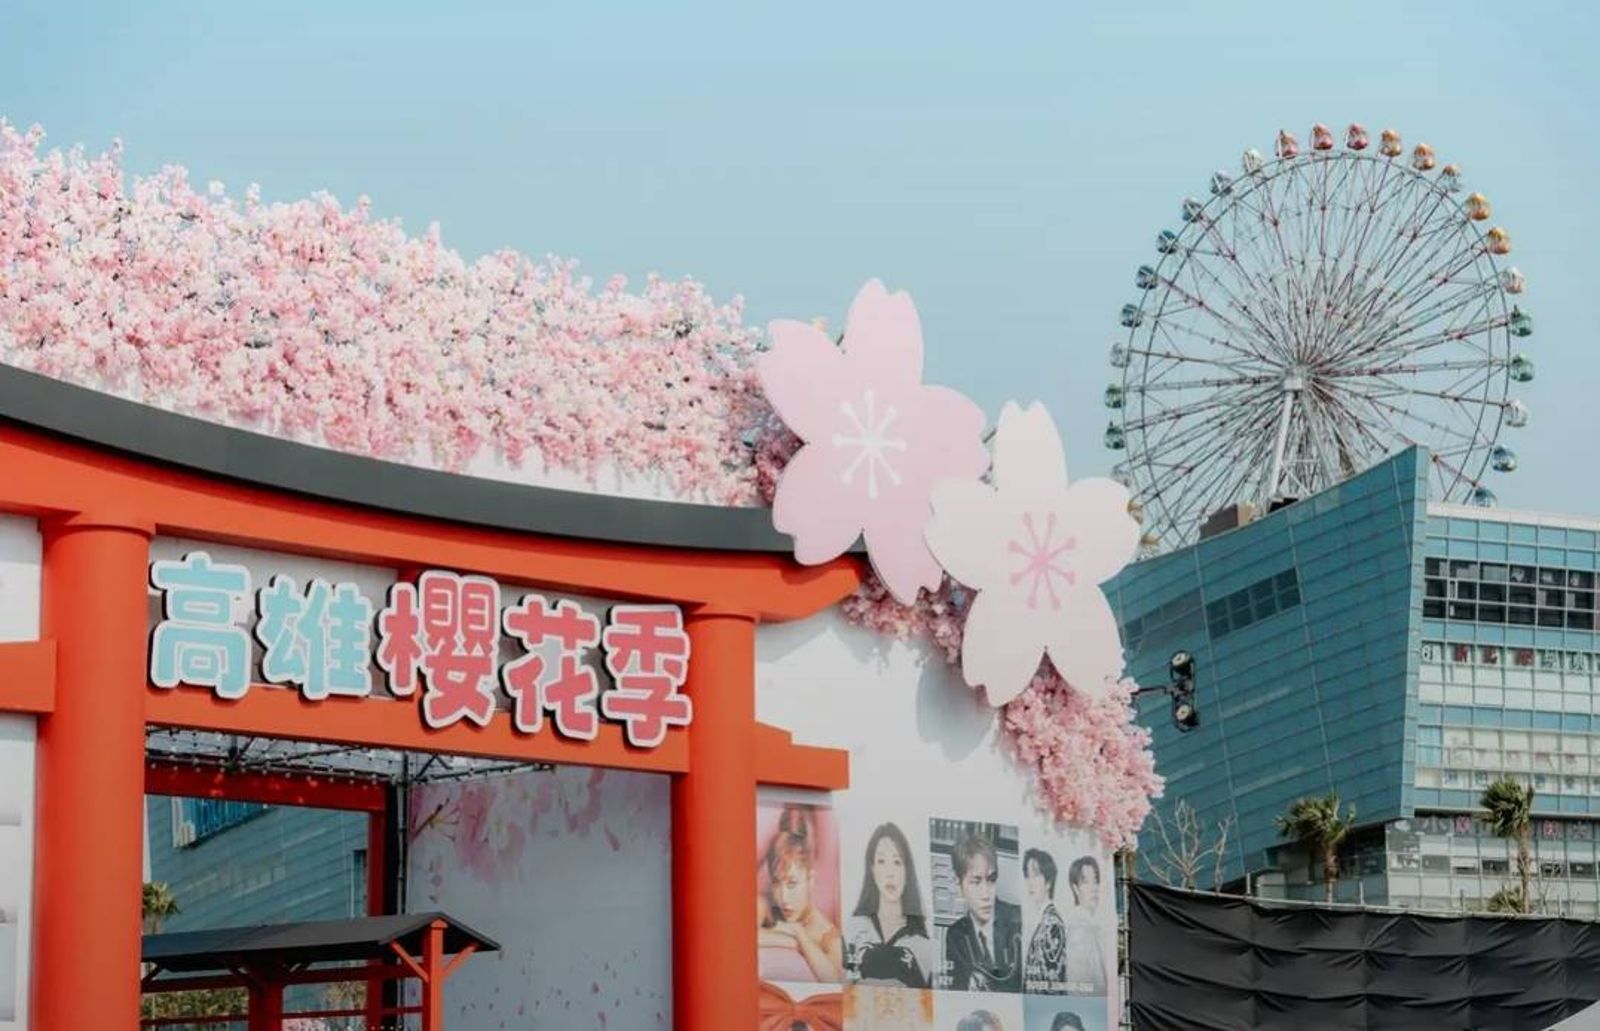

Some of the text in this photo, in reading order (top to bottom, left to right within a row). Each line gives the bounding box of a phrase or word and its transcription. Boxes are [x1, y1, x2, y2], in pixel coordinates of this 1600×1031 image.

[150, 552, 693, 748] 高雄櫻花季
